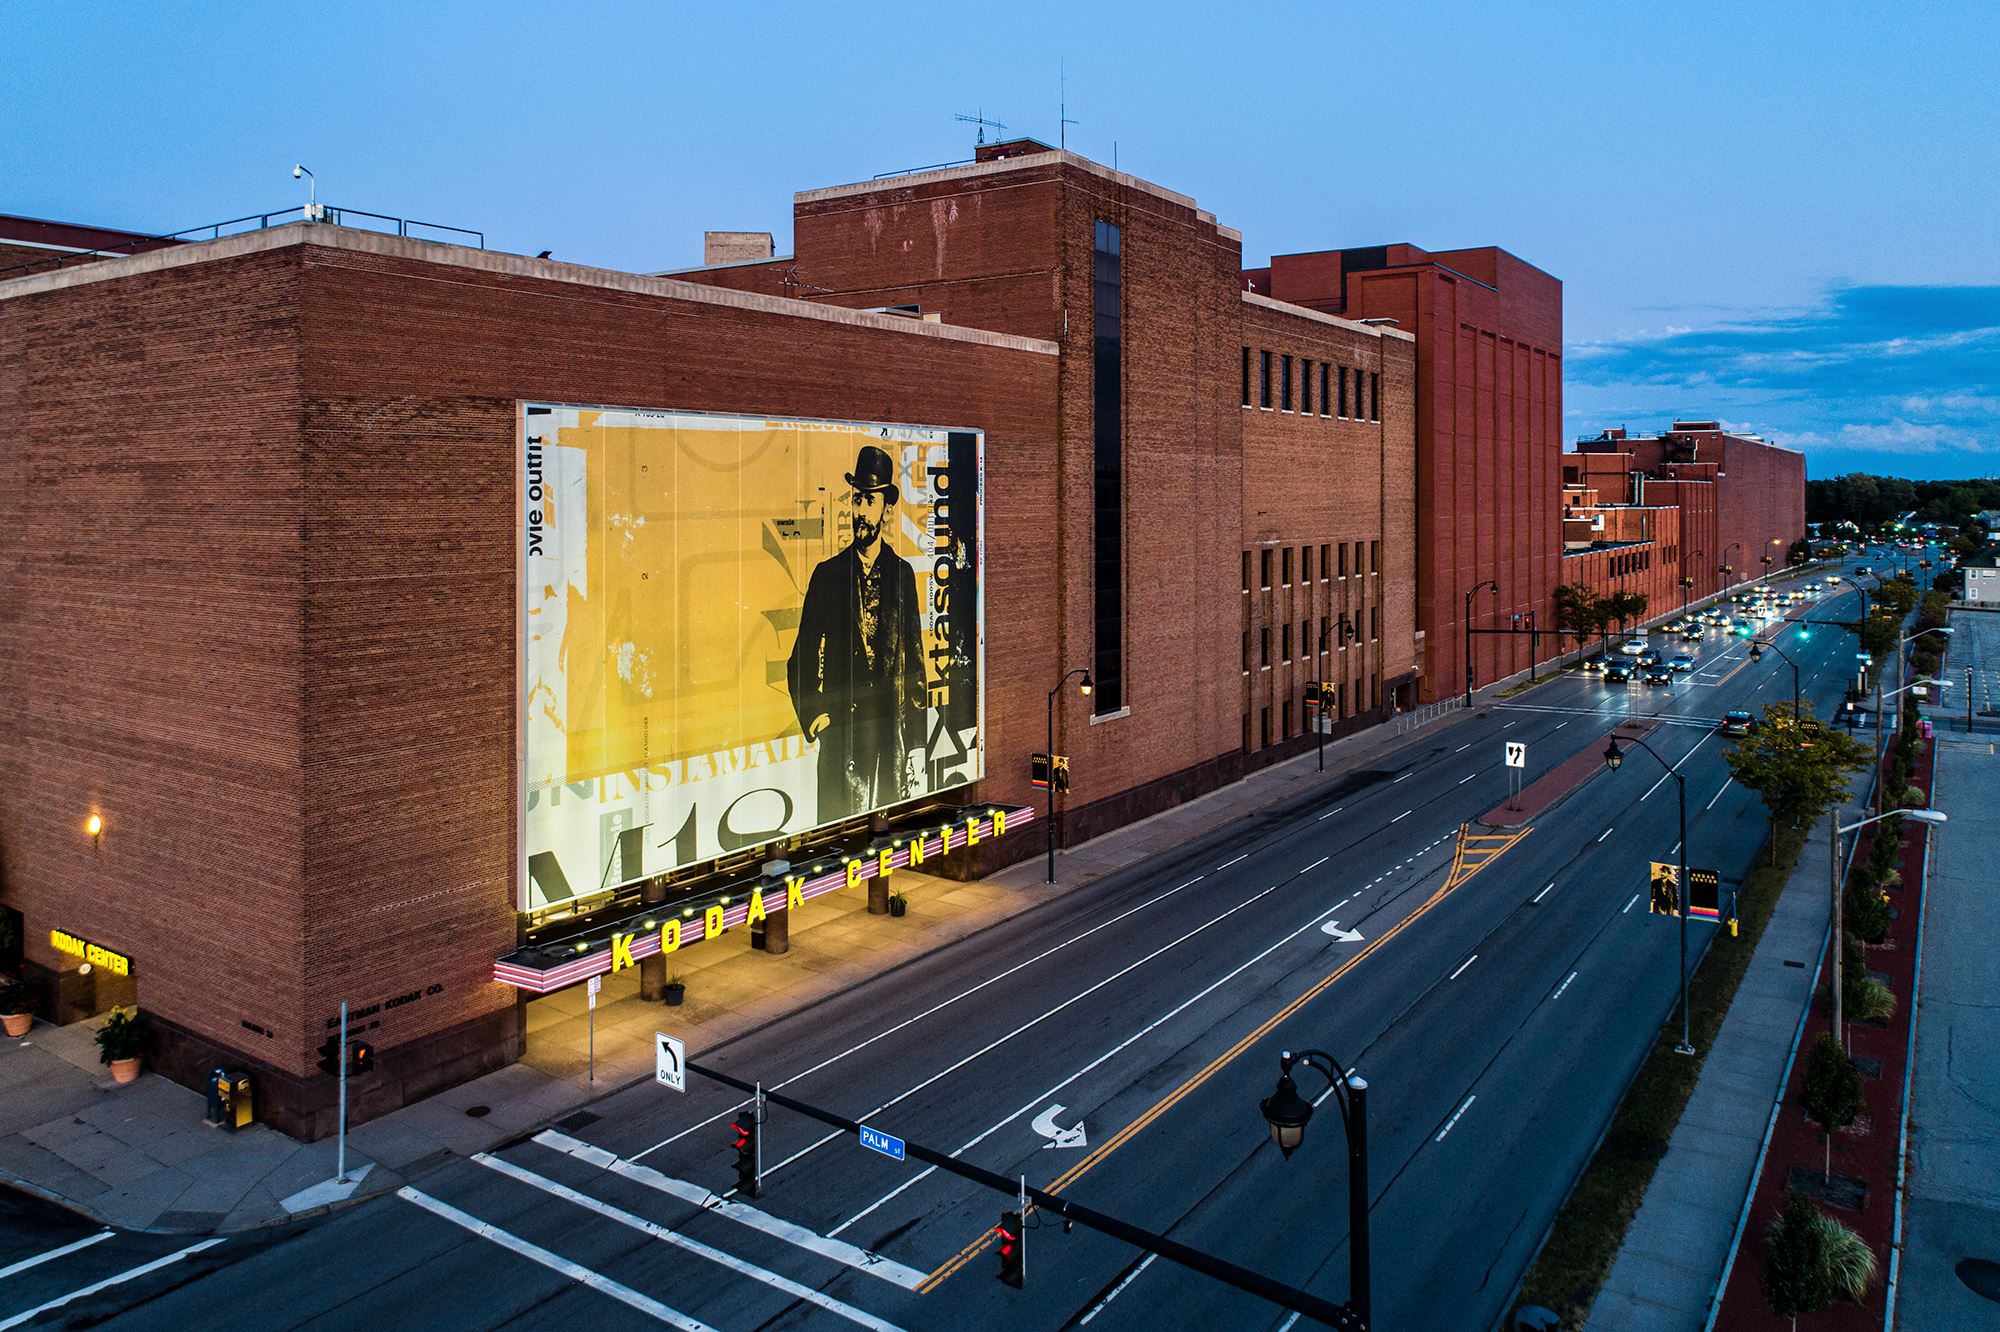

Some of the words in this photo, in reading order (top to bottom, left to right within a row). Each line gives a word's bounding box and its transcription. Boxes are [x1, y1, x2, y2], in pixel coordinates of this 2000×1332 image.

[927, 467, 951, 709] Ektasound
[612, 877, 805, 973] KODAK
[846, 809, 1007, 889] CENTER
[50, 929, 86, 959] KODAK
[86, 943, 129, 976] CENTER
[327, 1003, 380, 1029] EATMAN
[385, 990, 422, 1010] KODAK
[660, 1069, 681, 1085] ONLY
[863, 1131, 889, 1150] PALM
